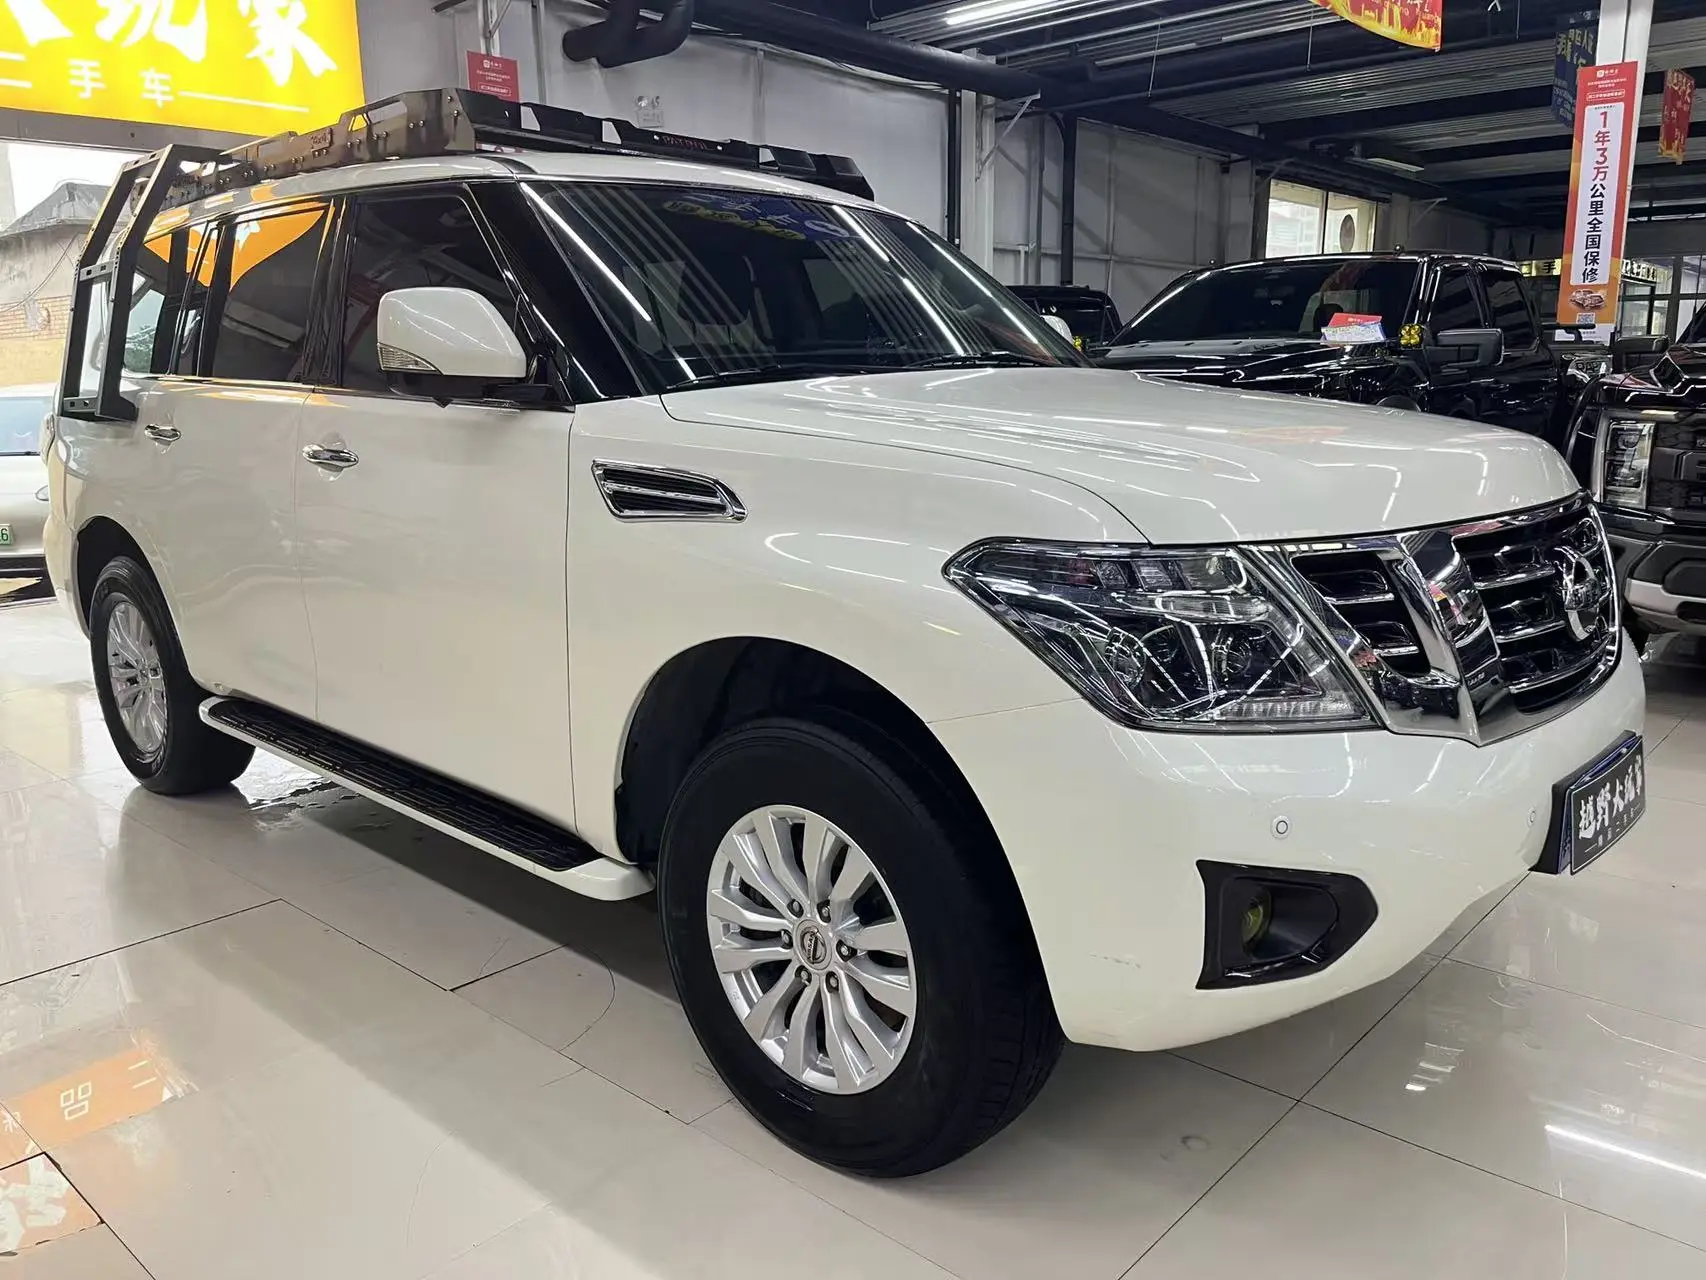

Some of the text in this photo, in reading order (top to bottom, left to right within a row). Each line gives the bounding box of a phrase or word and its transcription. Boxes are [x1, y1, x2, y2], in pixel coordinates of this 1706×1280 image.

[0, 0, 338, 86] 玩家
[1581, 110, 1611, 284] 1年3万公里全国保修
